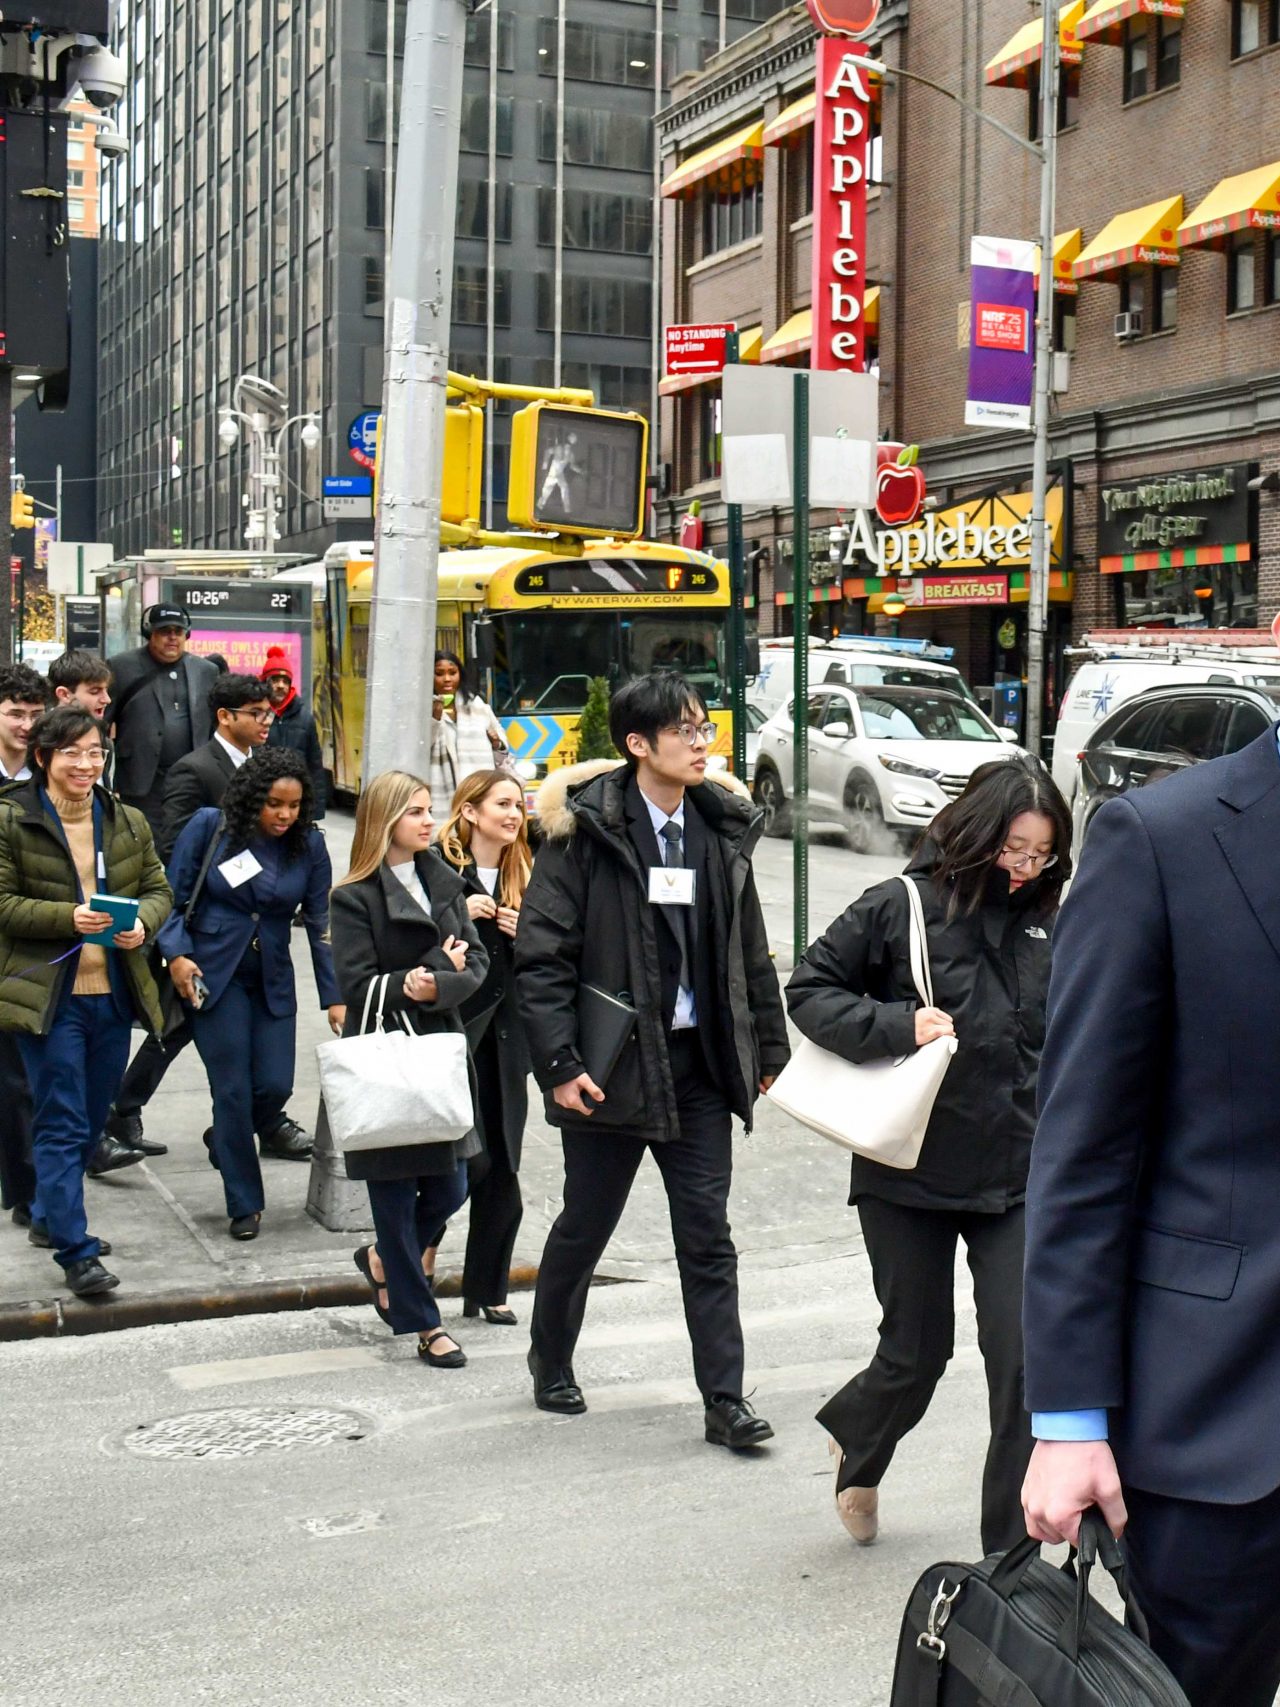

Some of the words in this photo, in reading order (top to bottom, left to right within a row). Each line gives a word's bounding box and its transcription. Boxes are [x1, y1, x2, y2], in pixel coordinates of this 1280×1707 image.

[824, 53, 870, 373] Applebe
[982, 310, 1007, 323] NRF
[668, 330, 681, 341] NO
[683, 328, 726, 340] STANDING
[981, 329, 995, 338] BIG
[997, 331, 1021, 340] SHOW
[668, 342, 705, 354] Anytime
[842, 508, 1032, 577] Applebee'
[528, 575, 544, 587] 245
[691, 573, 706, 585] 245
[925, 583, 1003, 598] BREAKFAST
[231, 641, 259, 655] OWLS
[1008, 690, 1017, 702] P
